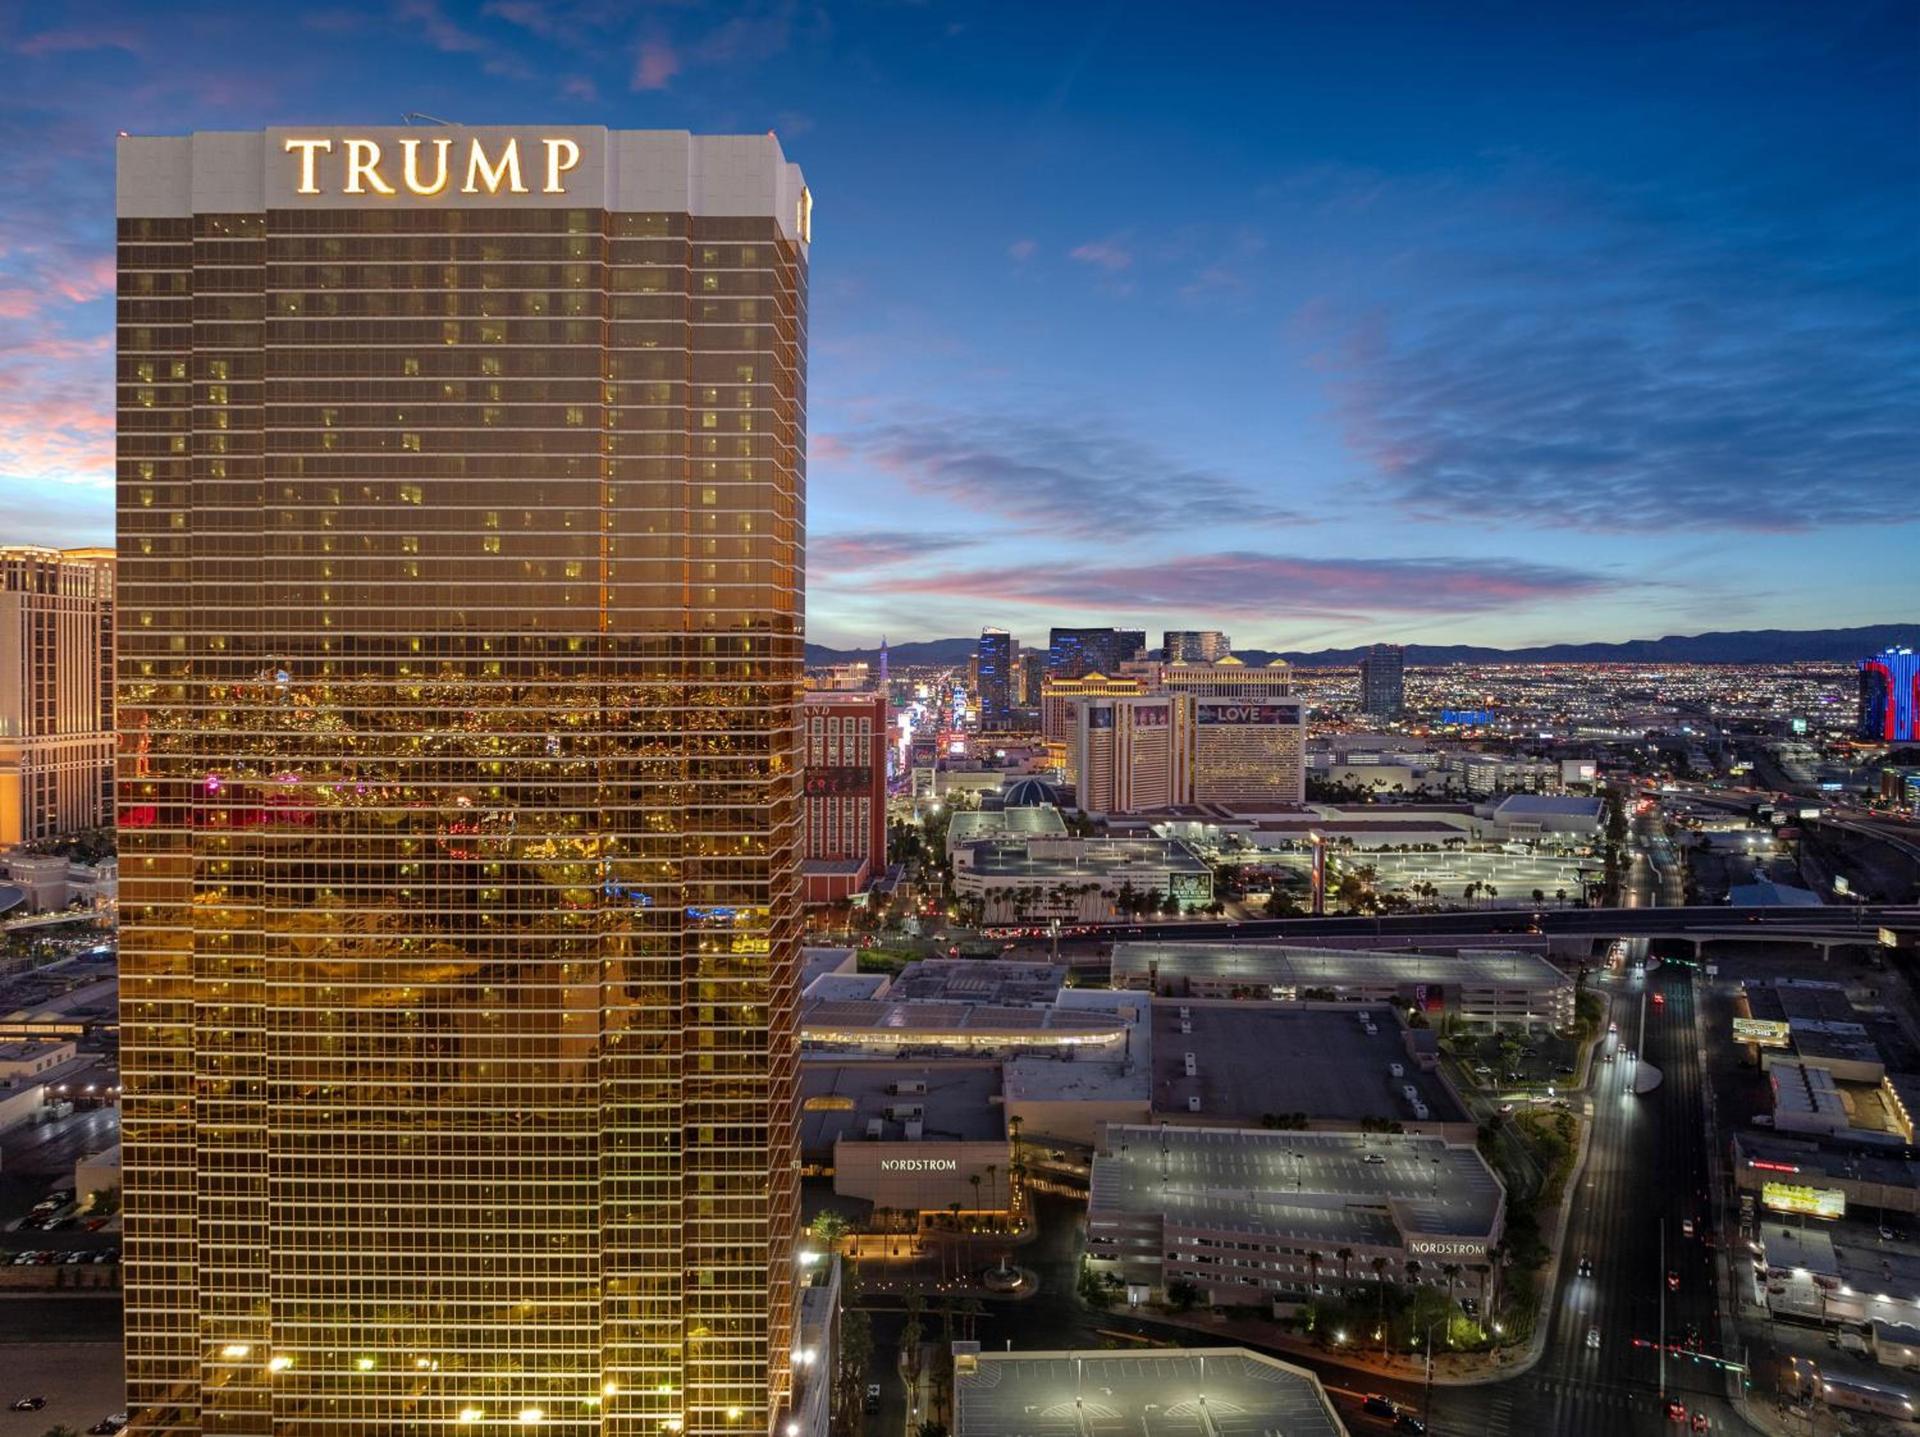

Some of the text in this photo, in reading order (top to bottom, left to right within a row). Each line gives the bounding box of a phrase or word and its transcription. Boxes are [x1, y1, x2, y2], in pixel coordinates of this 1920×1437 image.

[285, 138, 581, 195] TRUMP
[1217, 707, 1260, 721] LOVE
[881, 1159, 956, 1171] NORDSTROM
[1411, 1242, 1485, 1255] NORDSTROM
